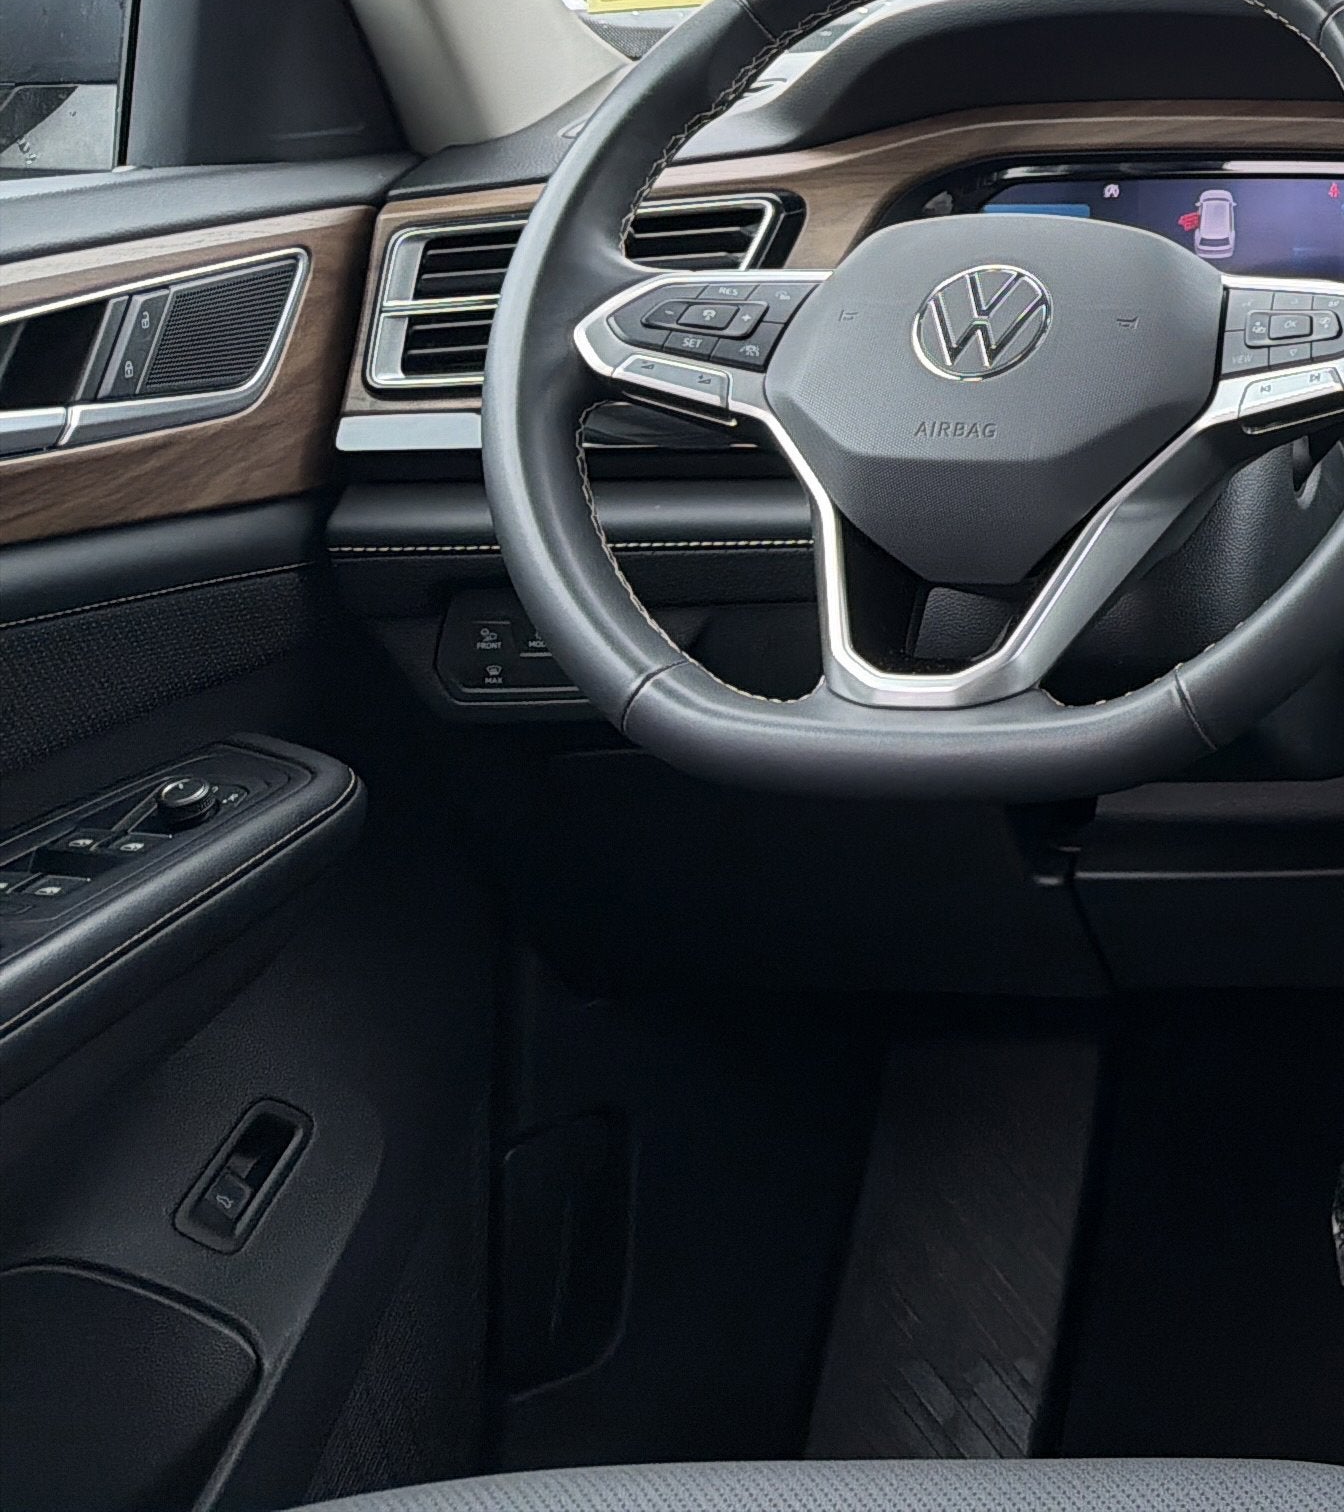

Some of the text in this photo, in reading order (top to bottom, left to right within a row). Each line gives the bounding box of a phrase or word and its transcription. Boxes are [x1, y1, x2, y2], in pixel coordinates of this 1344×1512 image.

[718, 286, 738, 296] RES
[918, 267, 1052, 376] VW
[1284, 319, 1298, 329] OK
[681, 337, 703, 349] SET
[1231, 353, 1254, 365] VIEW
[914, 420, 998, 439] AIRBAG
[476, 641, 502, 650] FRONT
